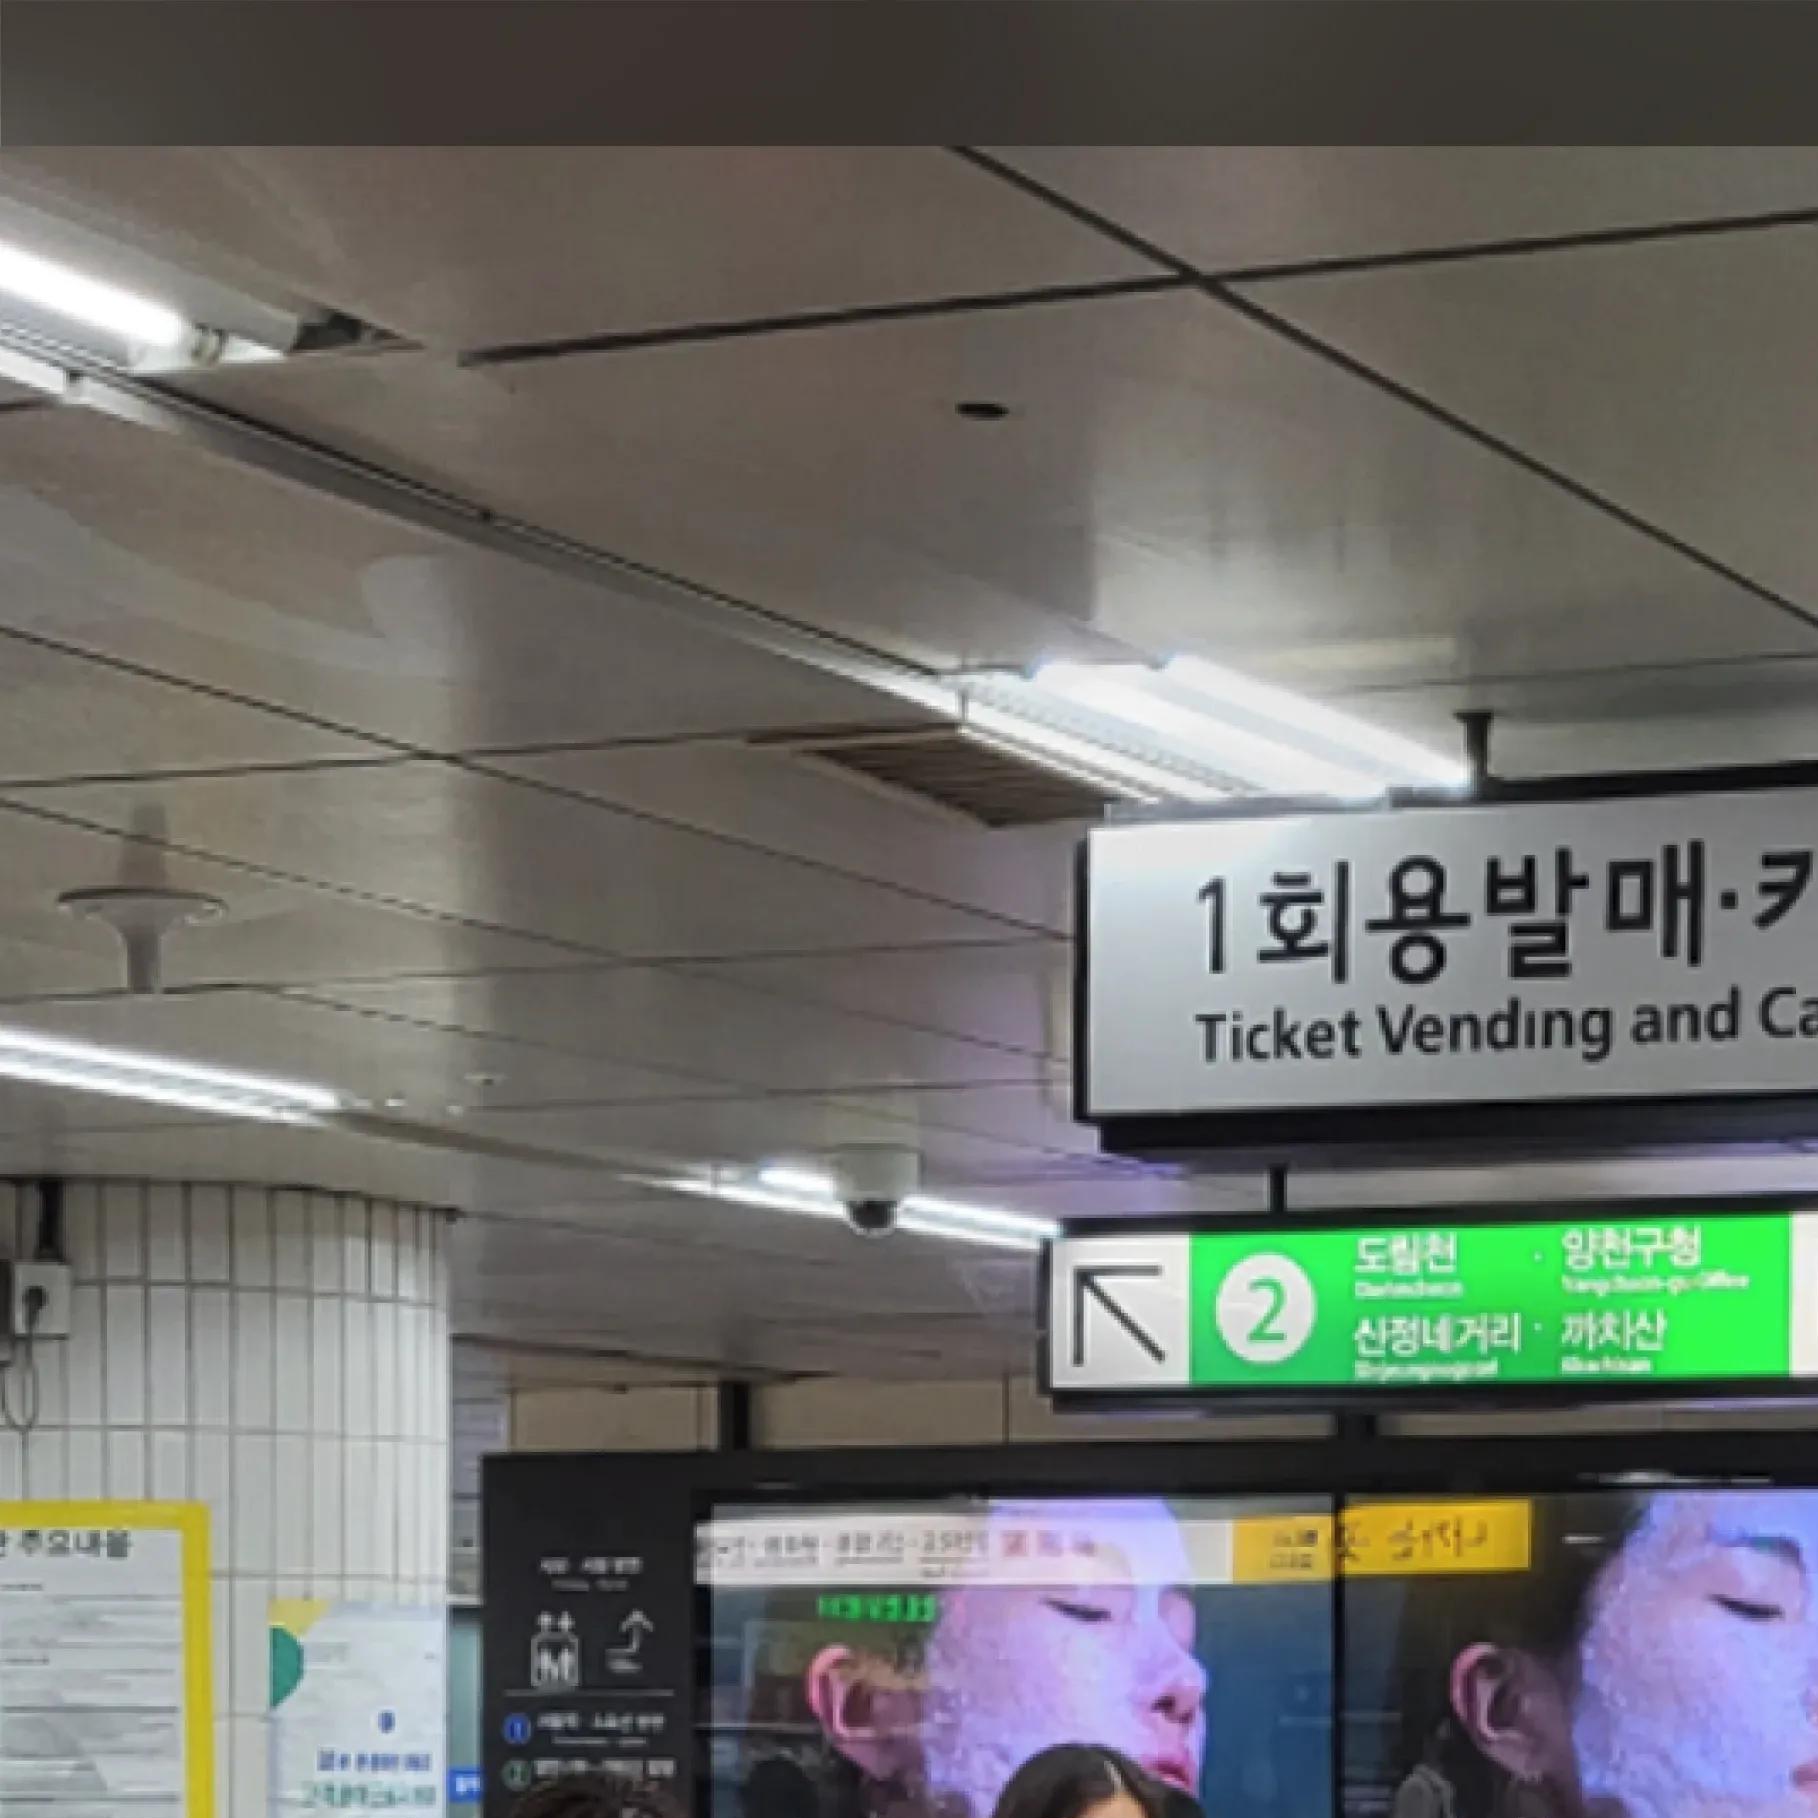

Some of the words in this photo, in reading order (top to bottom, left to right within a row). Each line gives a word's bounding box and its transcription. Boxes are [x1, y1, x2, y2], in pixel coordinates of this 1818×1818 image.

[1194, 1006, 1362, 1063] Ticket
[1375, 996, 1614, 1063] Vending
[1630, 984, 1741, 1045] and
[1246, 1278, 1288, 1343] 2
